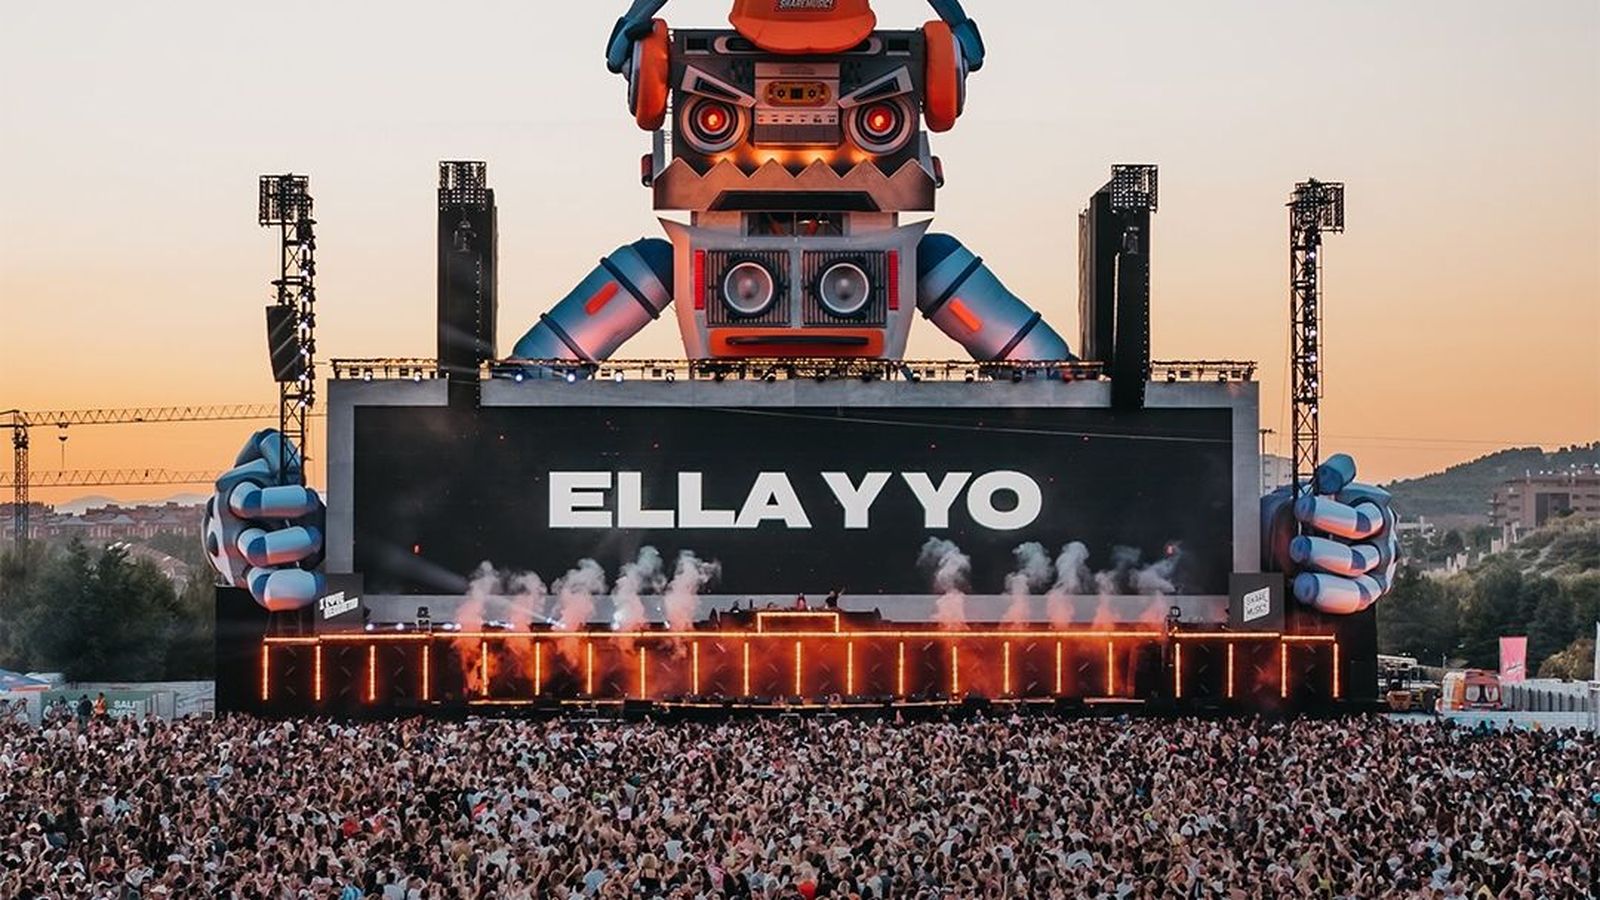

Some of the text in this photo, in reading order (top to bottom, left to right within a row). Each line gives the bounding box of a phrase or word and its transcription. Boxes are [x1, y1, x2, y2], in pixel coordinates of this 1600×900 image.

[548, 470, 1043, 531] ELLA Y YO
